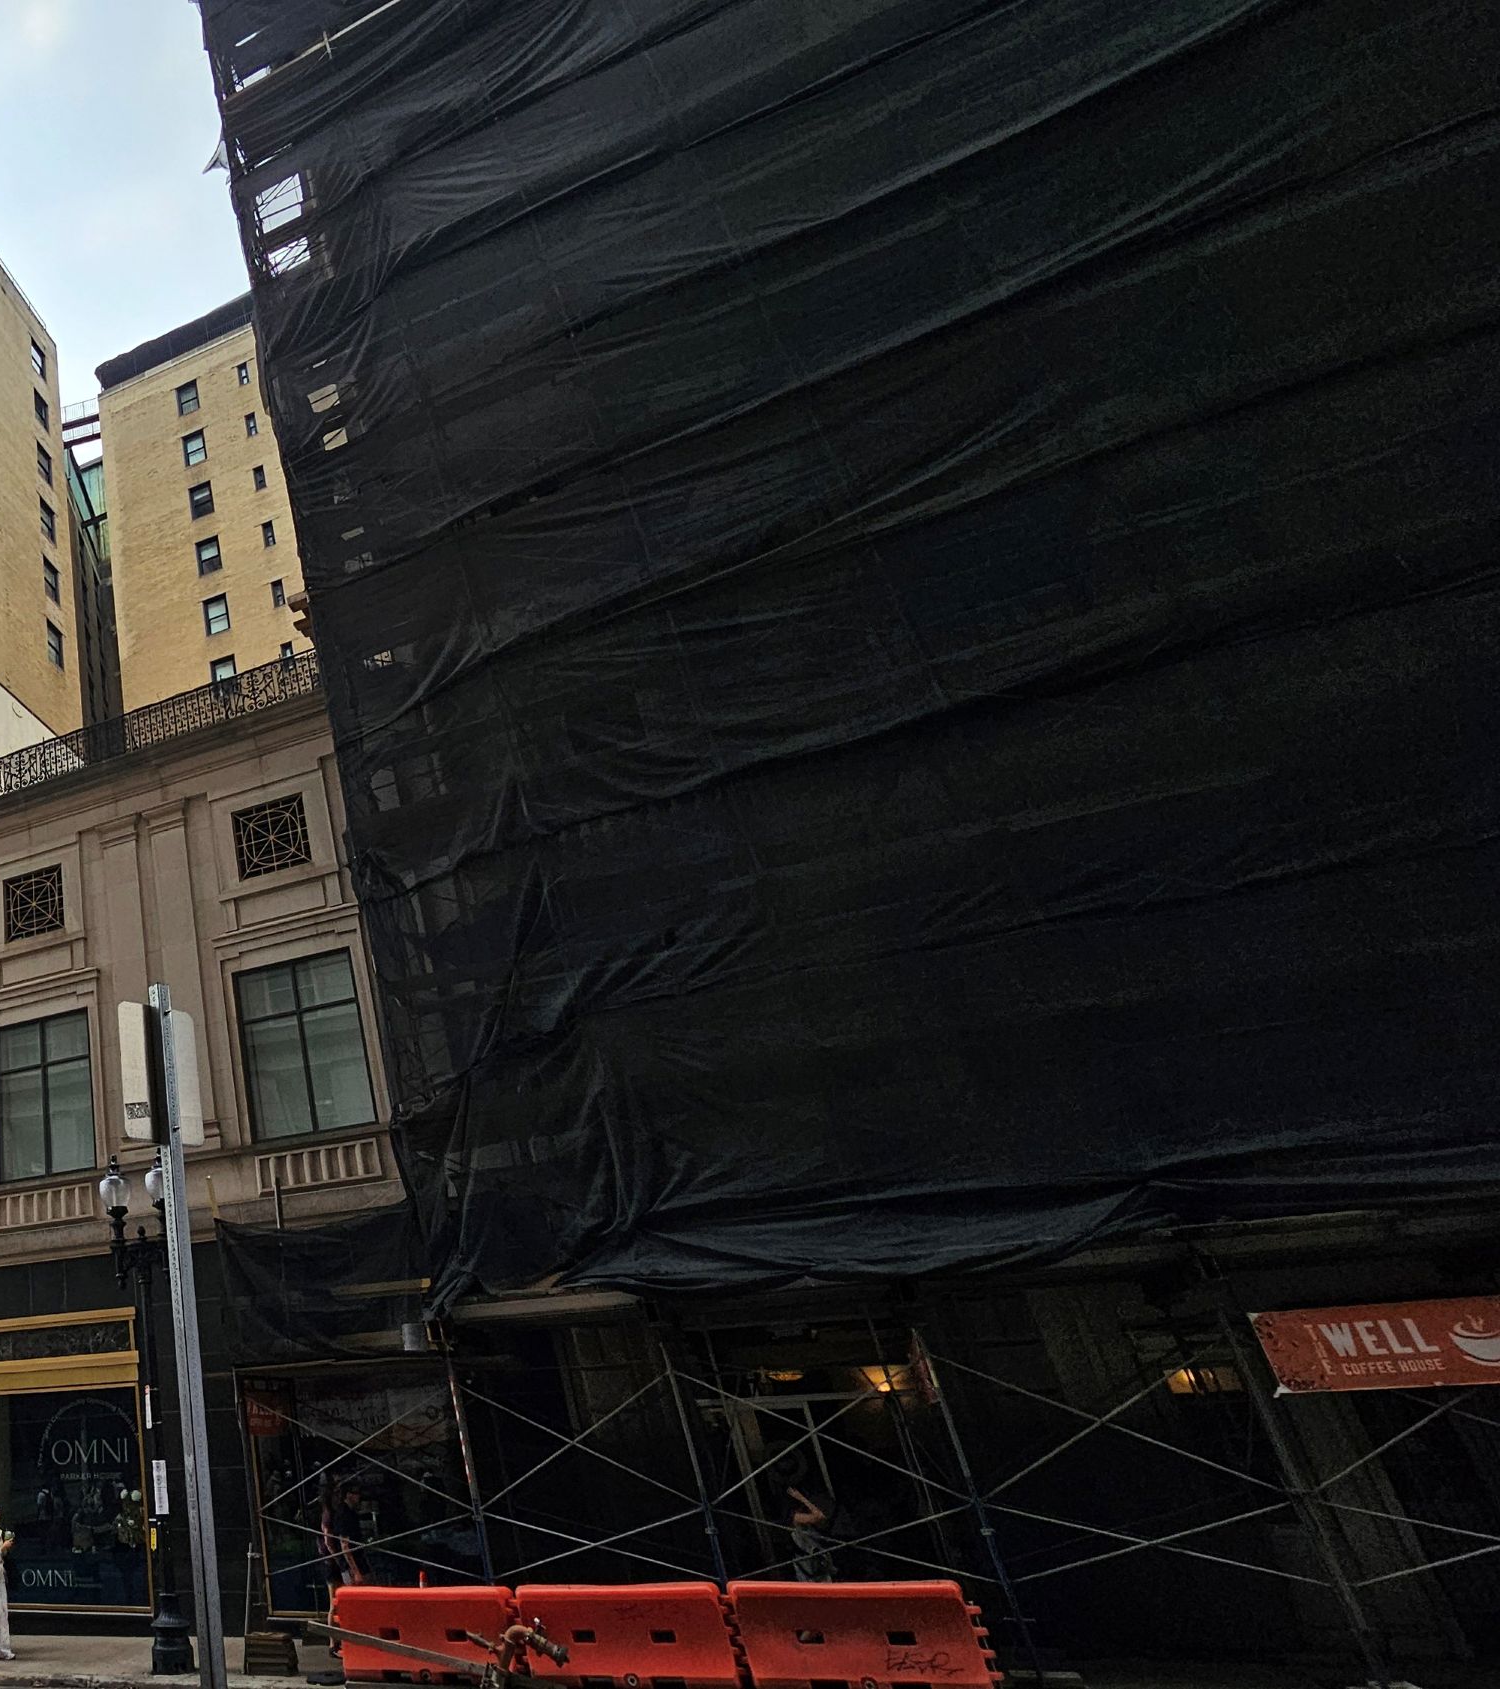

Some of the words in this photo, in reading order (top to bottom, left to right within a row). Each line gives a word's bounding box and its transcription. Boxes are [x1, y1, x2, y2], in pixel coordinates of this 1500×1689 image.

[1318, 1318, 1441, 1357] WELL
[1343, 1360, 1397, 1376] COFFEE
[1399, 1358, 1446, 1374] HOUSE
[51, 1437, 129, 1466] OMNI
[60, 1472, 92, 1481] PARKER
[21, 1568, 73, 1588] OMNI
